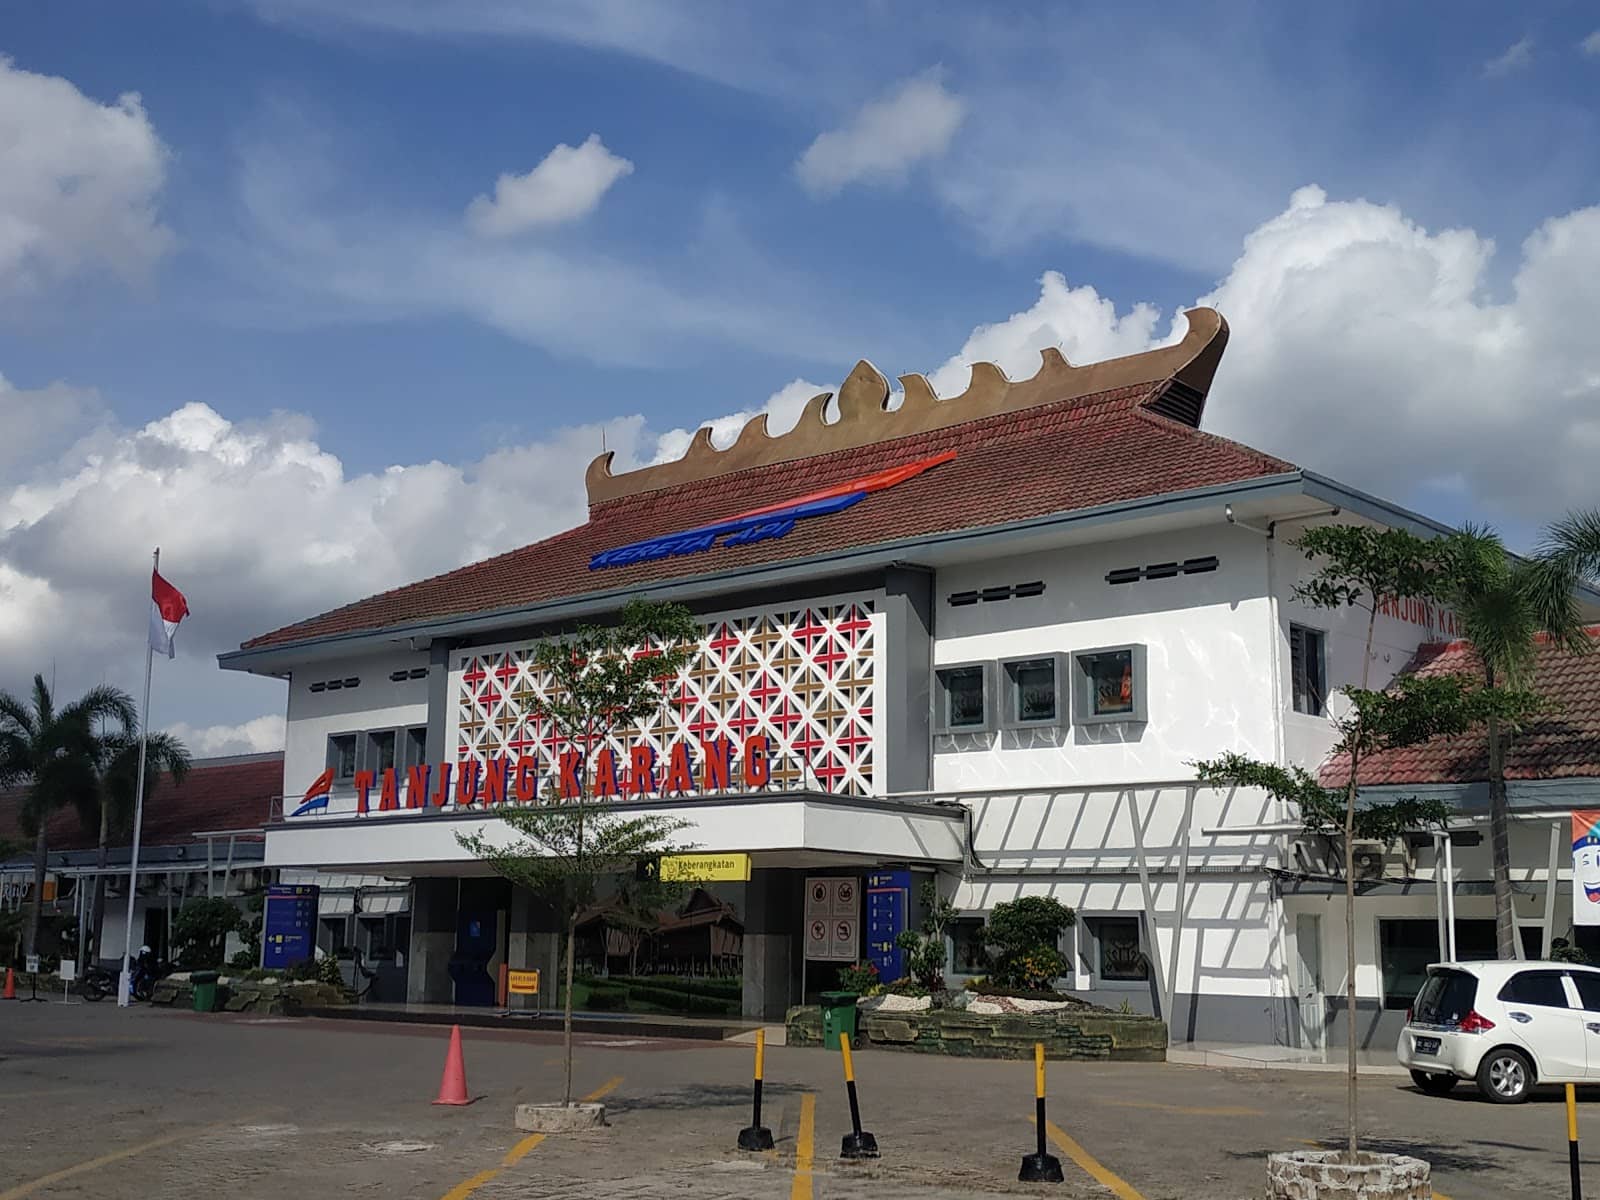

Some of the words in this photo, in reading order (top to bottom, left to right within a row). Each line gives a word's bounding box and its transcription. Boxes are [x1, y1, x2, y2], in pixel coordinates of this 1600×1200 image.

[588, 533, 716, 571] KERETA
[723, 519, 796, 548] API
[354, 756, 539, 813] TANJUNG
[559, 736, 771, 798] KARANG
[679, 859, 735, 872] Keberangkatan
